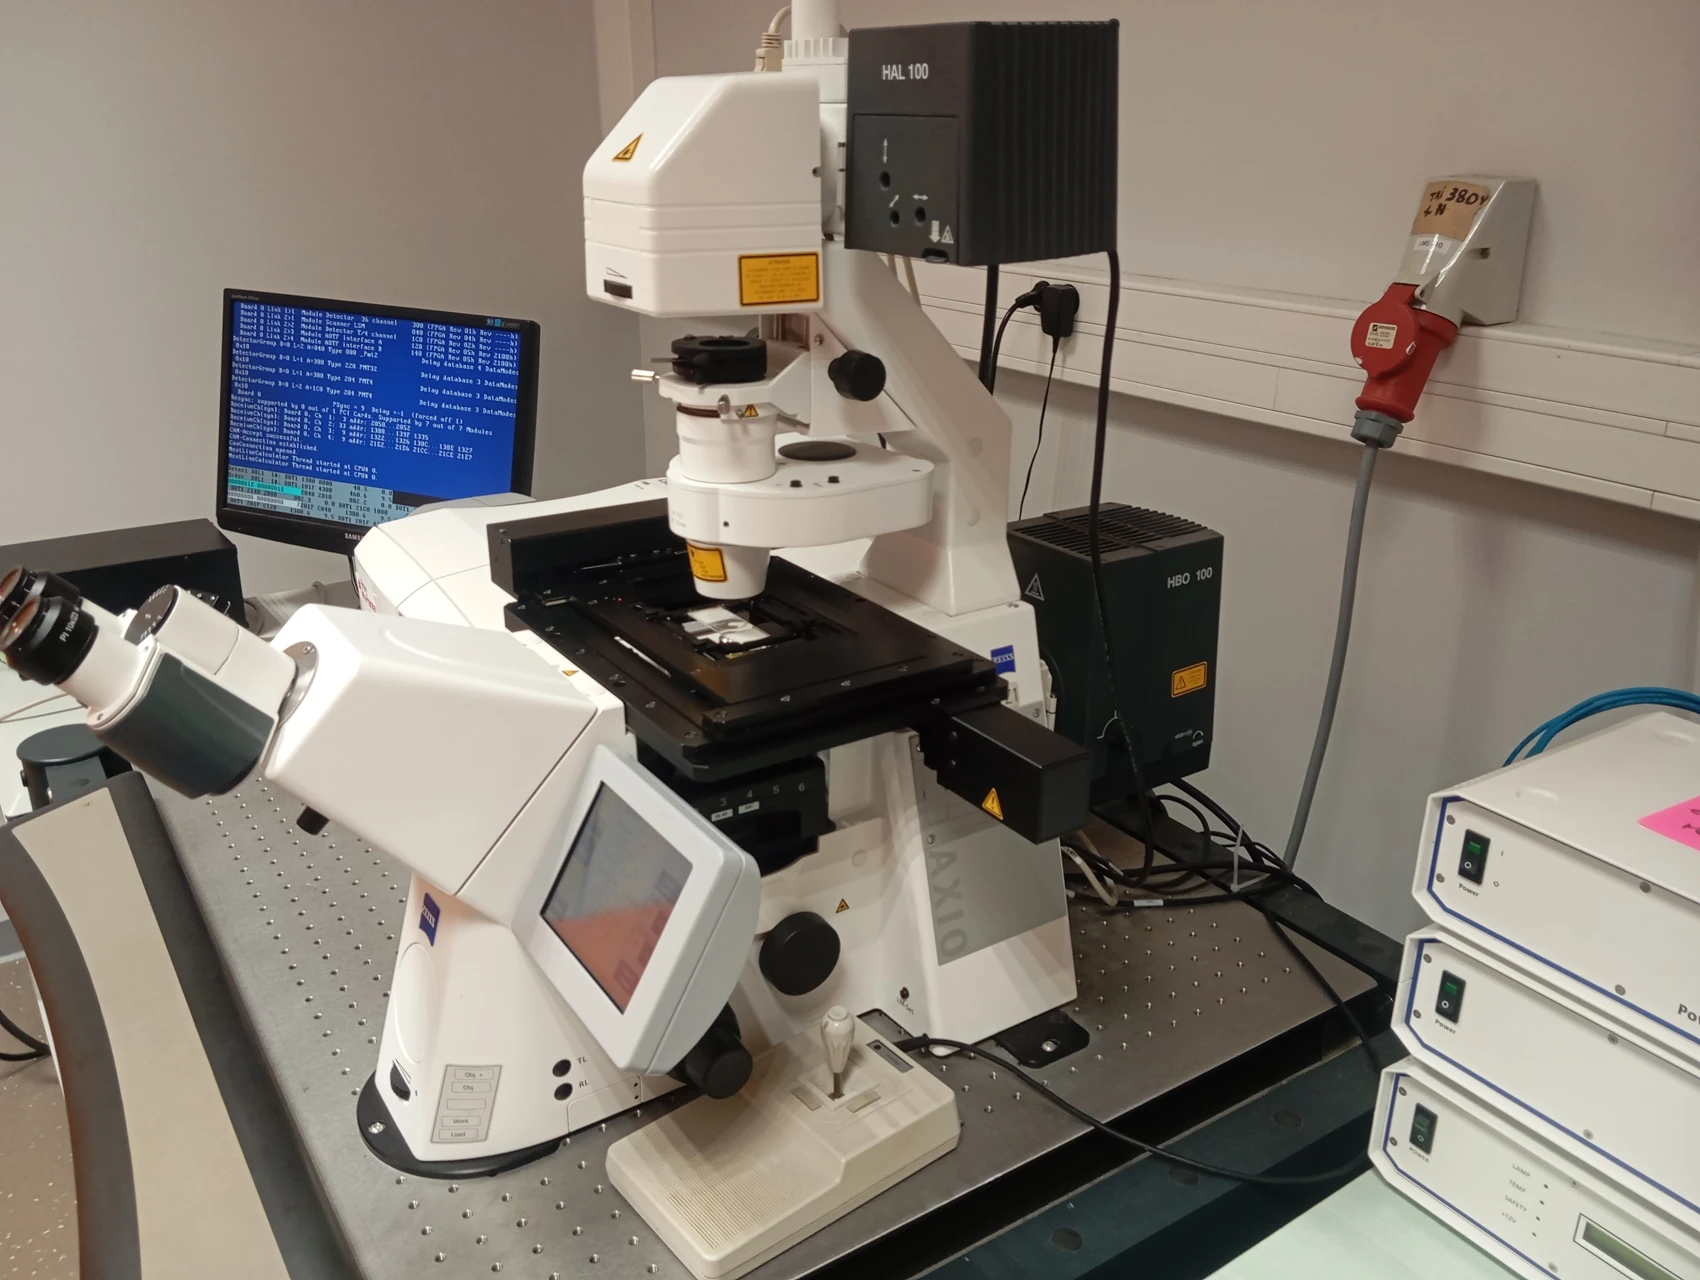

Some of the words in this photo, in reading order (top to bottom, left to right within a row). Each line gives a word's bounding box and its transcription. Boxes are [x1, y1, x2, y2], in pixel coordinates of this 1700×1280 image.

[882, 64, 906, 80] HAL
[908, 63, 929, 80] 100
[326, 312, 354, 321] Detector
[372, 317, 398, 326] channel
[326, 319, 350, 327] Scanner
[325, 326, 354, 335] Detector
[371, 331, 397, 340] channel
[343, 335, 375, 344] interface
[342, 342, 374, 351] interface
[328, 347, 342, 355] Type
[422, 358, 440, 367] Delay
[444, 360, 474, 370] database
[257, 398, 288, 408] supported
[353, 411, 375, 419] Cards.
[378, 414, 411, 425] Supported
[467, 426, 493, 436] Modules
[292, 456, 313, 464] Thread
[316, 459, 341, 468] started
[292, 462, 313, 470] Thread
[316, 466, 340, 475] started
[344, 533, 364, 541] SAMS
[1167, 572, 1191, 589] HBO
[1196, 566, 1213, 581] 100
[993, 653, 1015, 664] ZEISS
[720, 798, 727, 806] 3
[773, 784, 780, 794] 5
[798, 783, 805, 791] 6
[1458, 883, 1480, 897] Power
[929, 852, 968, 957] AXIO
[1678, 1003, 1700, 1025] Po
[1434, 1018, 1456, 1034] Power
[1409, 1147, 1430, 1163] POWER
[1512, 1164, 1530, 1177] LAMP
[1509, 1179, 1526, 1192] TEMP
[1505, 1195, 1527, 1212] SAFETY
[1501, 1212, 1516, 1224] +12V
